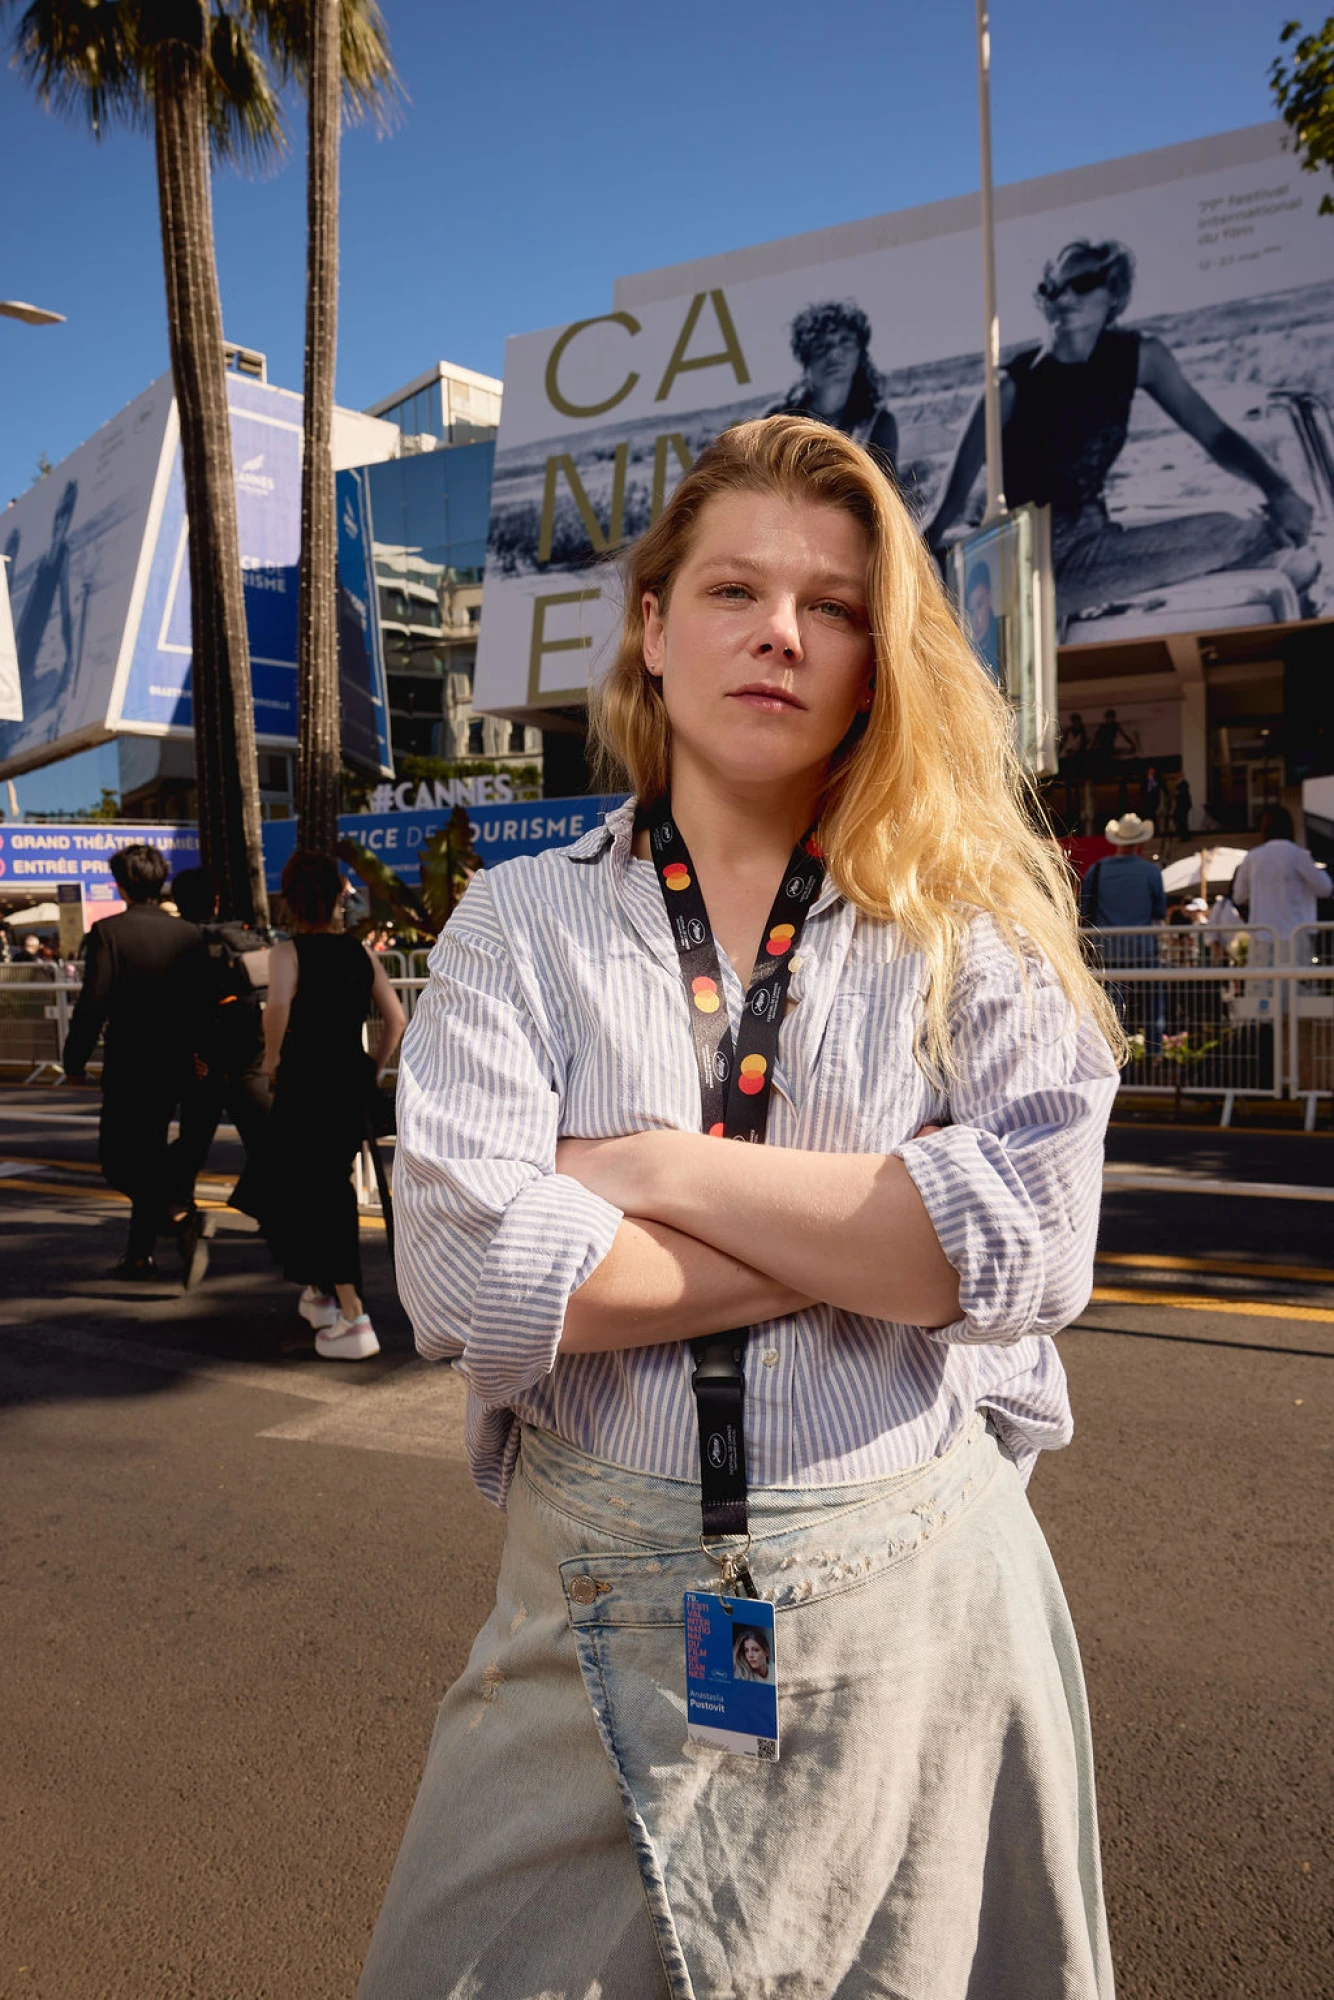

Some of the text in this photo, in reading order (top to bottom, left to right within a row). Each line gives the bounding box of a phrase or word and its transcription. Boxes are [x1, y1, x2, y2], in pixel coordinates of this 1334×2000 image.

[544, 287, 752, 419] CA
[371, 774, 514, 814] #CANNES
[468, 815, 585, 843] OURISME
[11, 835, 70, 850] GRAND
[13, 857, 78, 874] ENTRÉE
[690, 1699, 725, 1712] Pustovit
